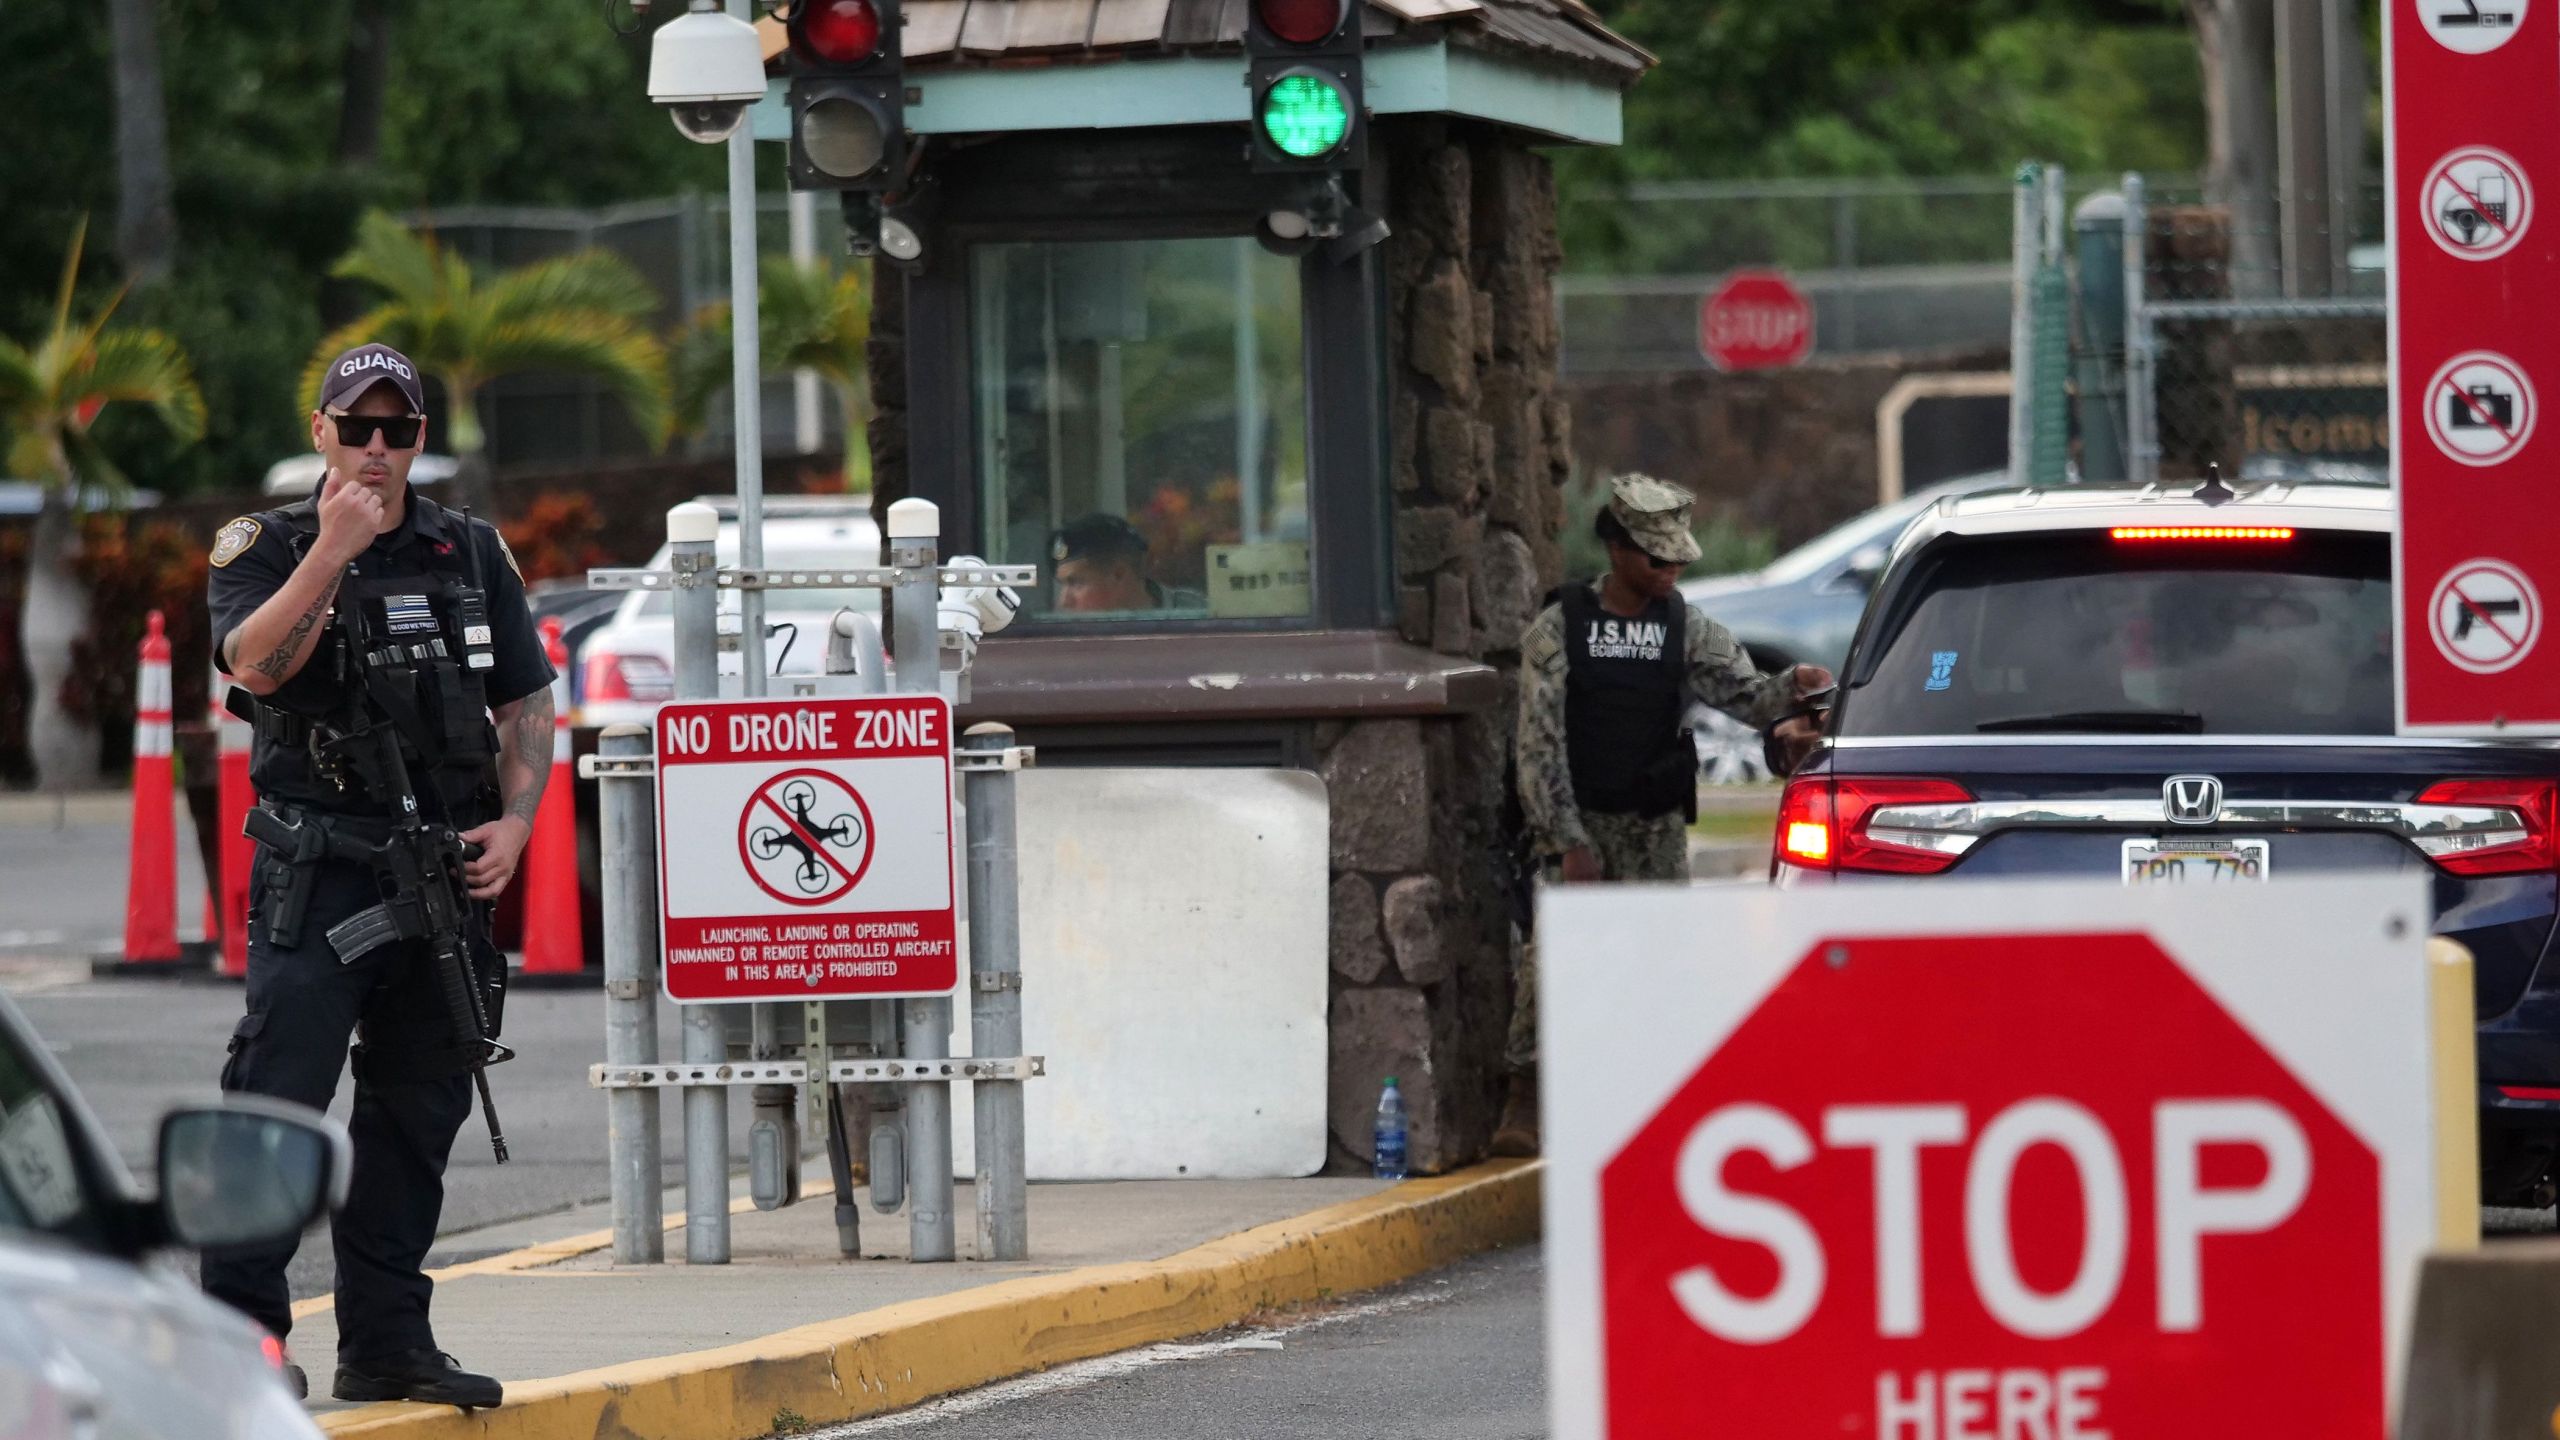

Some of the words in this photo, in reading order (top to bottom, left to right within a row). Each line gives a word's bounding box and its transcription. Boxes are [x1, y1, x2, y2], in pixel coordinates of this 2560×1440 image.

[1707, 305, 1808, 347] STOP
[340, 352, 412, 380] GUARD
[666, 715, 711, 755] NO
[729, 710, 838, 753] DRONE
[853, 708, 940, 750] ZONE
[701, 926, 772, 944] LAUNCHING,
[776, 924, 828, 942] LANDING
[833, 923, 850, 940] OR
[855, 922, 919, 939] OPERATING
[670, 946, 735, 964] UNMANNED
[741, 945, 757, 962] OR
[763, 944, 809, 961] REMOTE
[814, 942, 889, 959] CONTROLLED
[894, 940, 951, 957] AIRCRAFT
[725, 965, 738, 981] IN
[743, 964, 769, 980] THIS
[775, 962, 807, 979] AREA
[811, 962, 824, 979] IS
[829, 960, 898, 978] PROHIBITED
[1668, 1096, 2314, 1346] STOP
[1876, 1365, 2114, 1440] HERE
